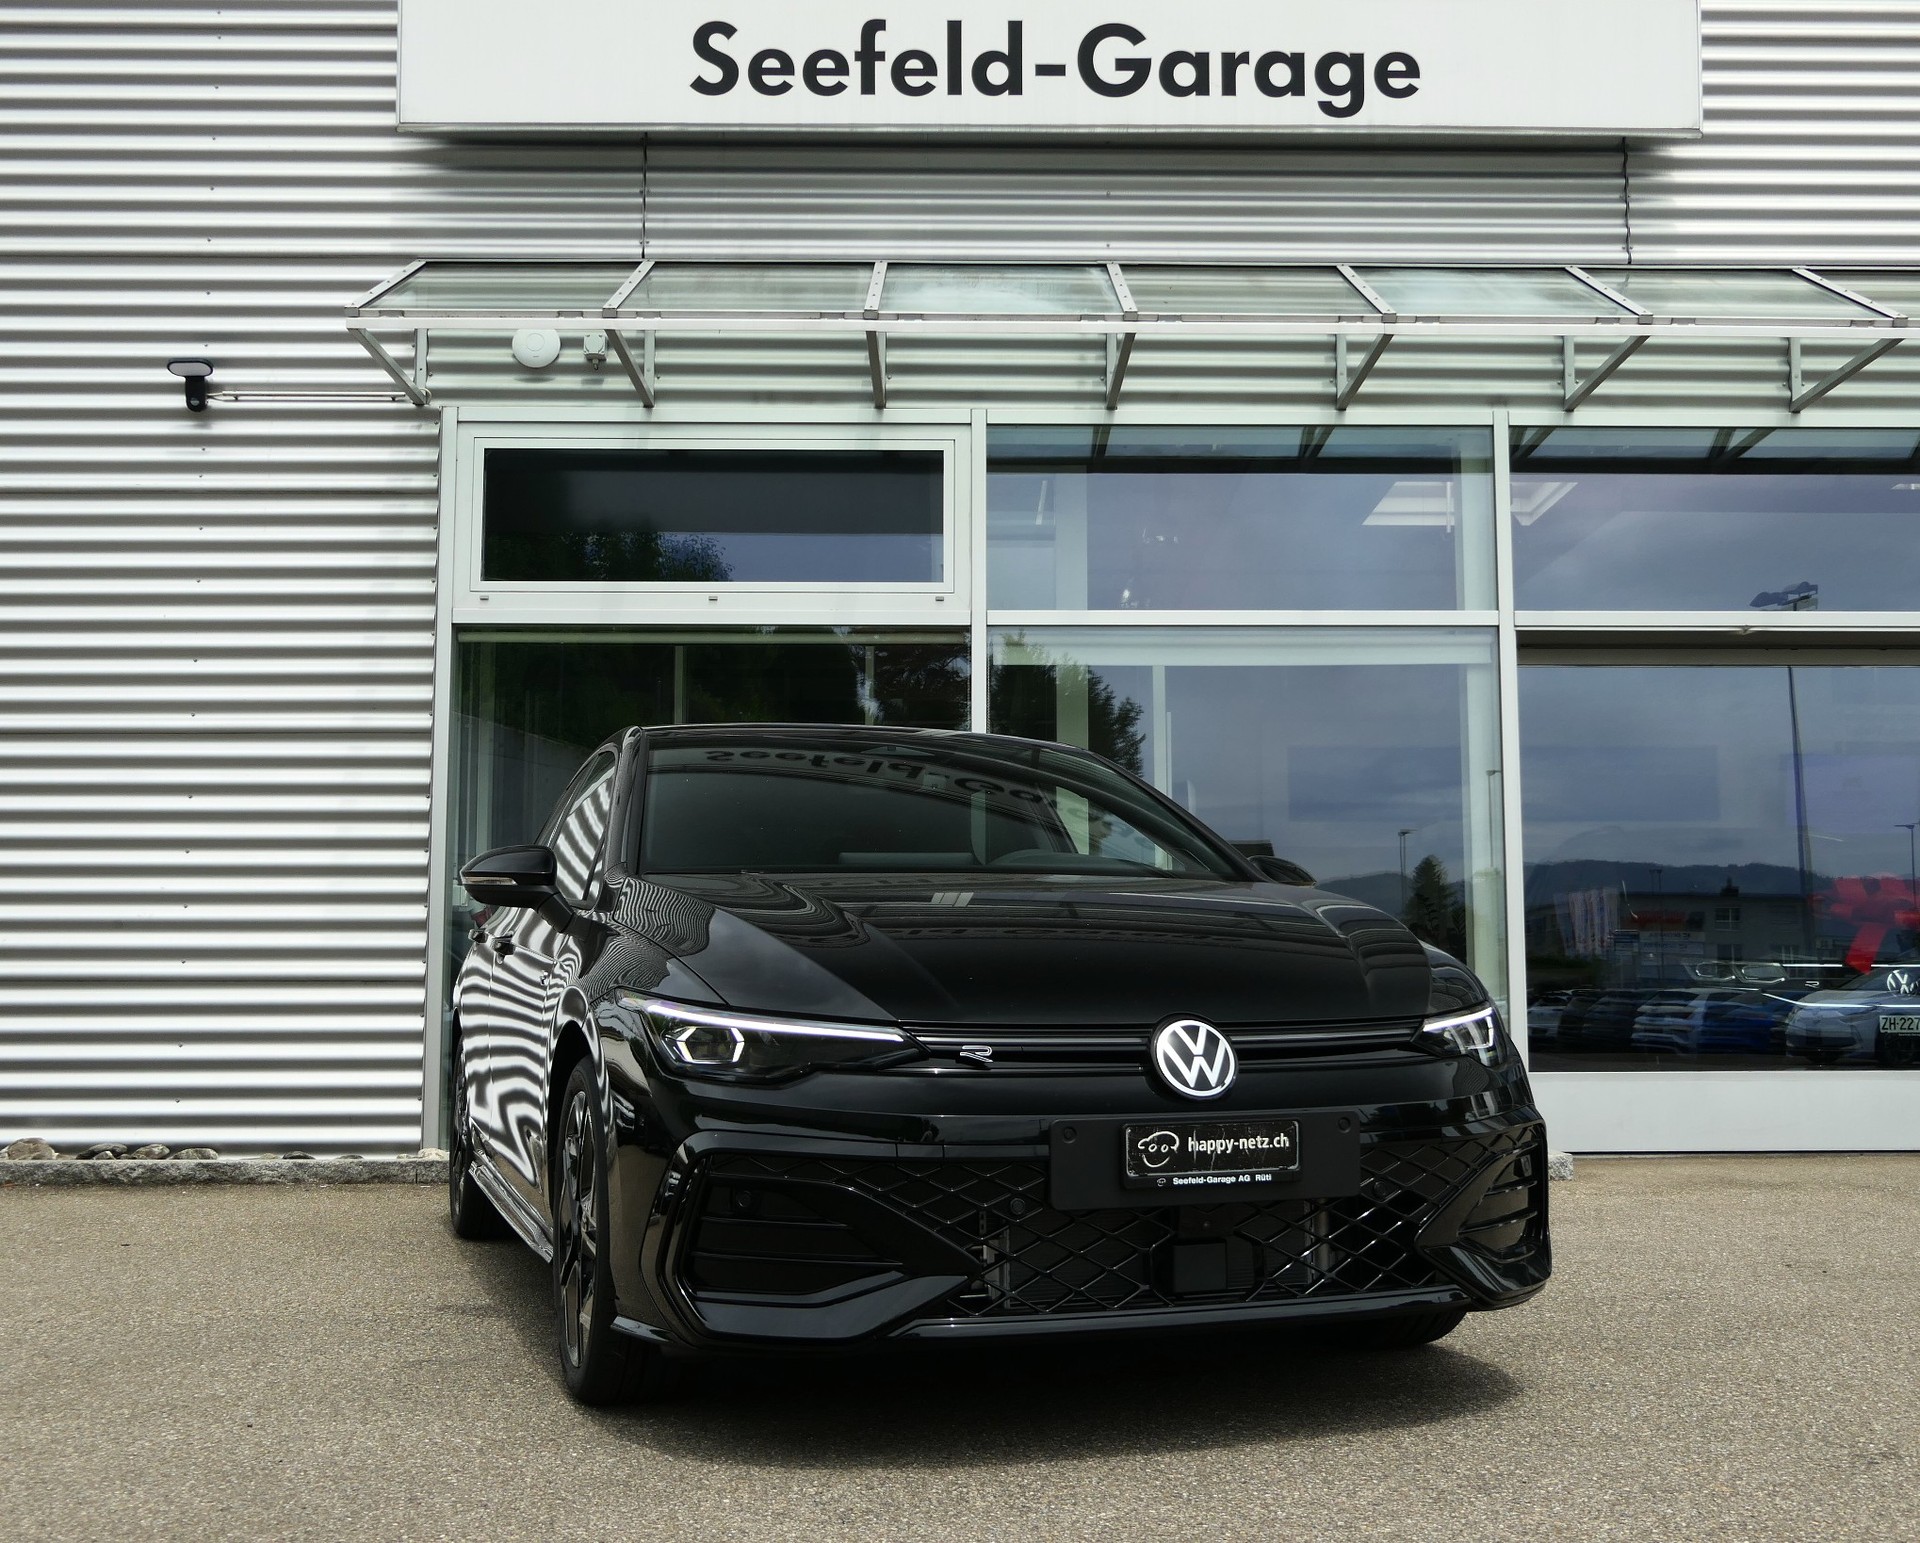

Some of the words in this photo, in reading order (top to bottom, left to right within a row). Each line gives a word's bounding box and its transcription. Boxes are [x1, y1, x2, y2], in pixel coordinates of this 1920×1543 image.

[689, 18, 1421, 118] Seefeld-Garage
[1159, 1022, 1231, 1092] VW
[1187, 1132, 1290, 1155] happy-netz.ch
[1172, 1175, 1236, 1186] Seefeld-Garage
[1238, 1175, 1250, 1183] AG
[1255, 1174, 1272, 1182] Rüti
